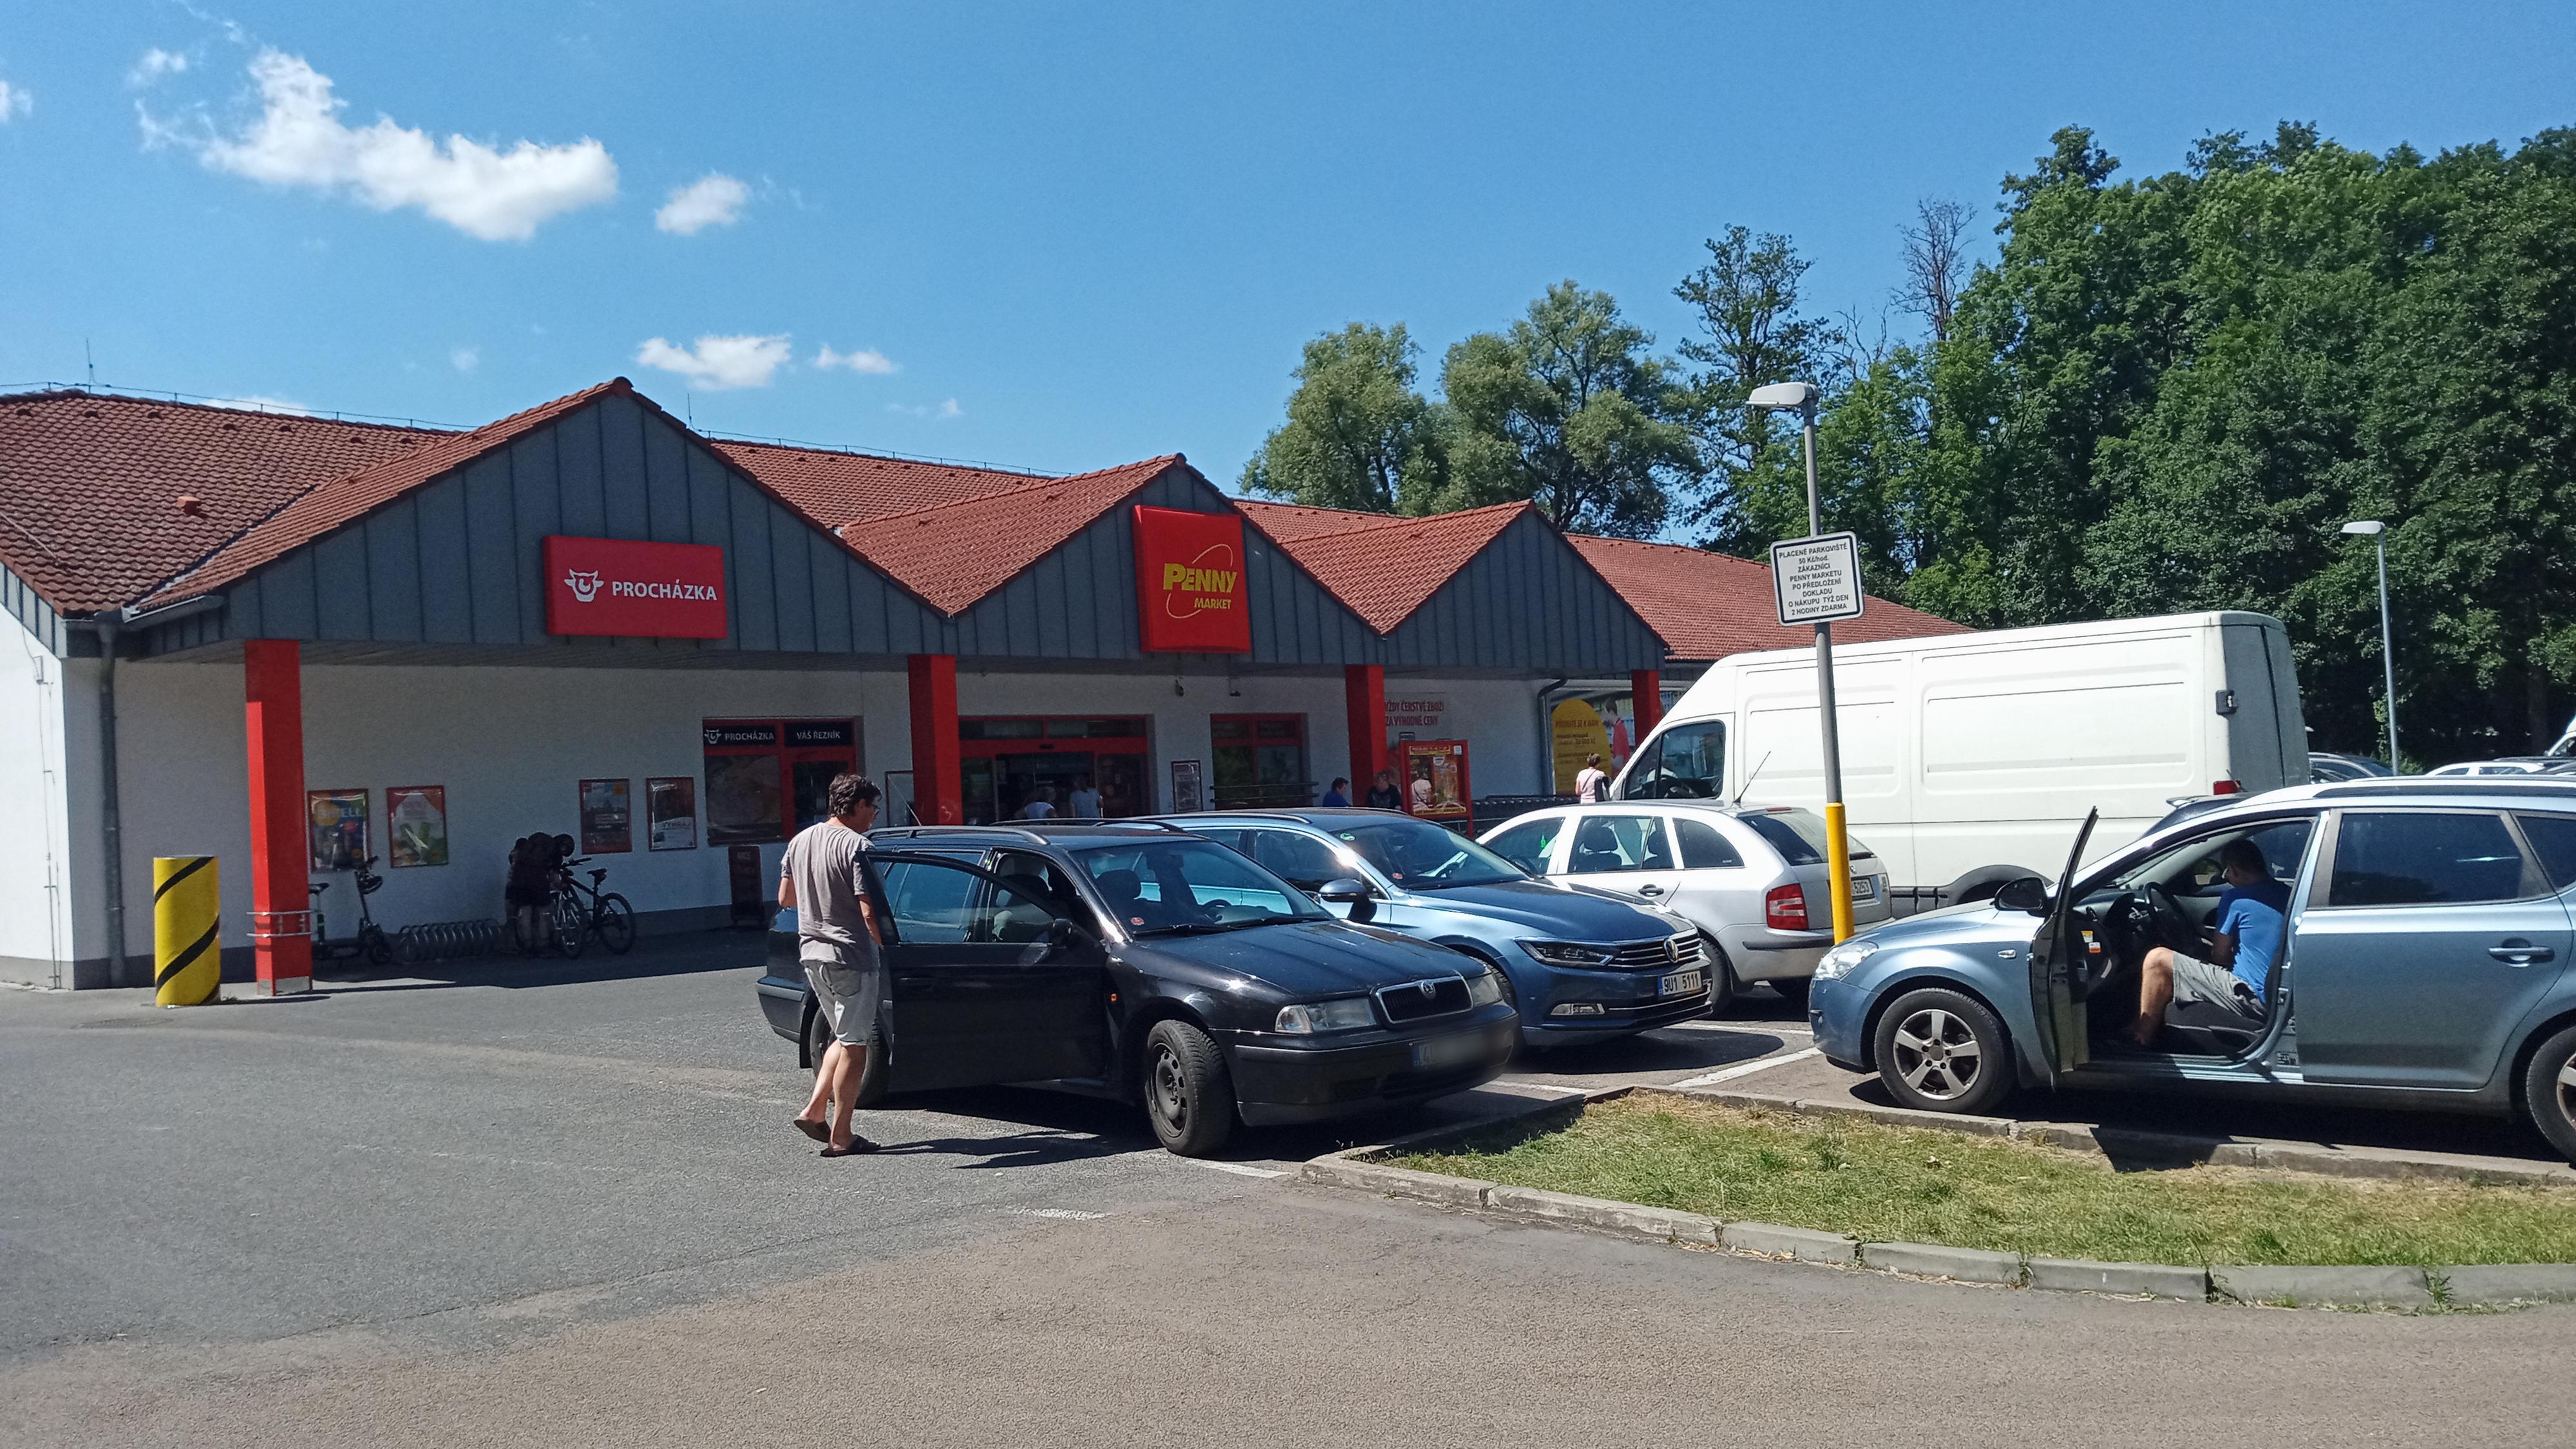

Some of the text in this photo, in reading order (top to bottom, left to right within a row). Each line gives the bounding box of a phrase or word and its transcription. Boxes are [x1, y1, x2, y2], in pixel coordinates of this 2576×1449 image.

[1779, 543, 1848, 558] PLACENÉ PARKOVIŠTÉ
[1798, 563, 1830, 573] ZÁKAZNÍCI
[1163, 564, 1237, 593] PENNY
[1790, 570, 1842, 582] PENNY MARKETU
[1803, 578, 1841, 589] PŘEDLOŽENÍ
[612, 579, 717, 601] PROCHÁZKA
[1803, 588, 1832, 597] DOKLADU
[1194, 598, 1232, 609] MARKET
[1794, 598, 1820, 606] NÁKUPU
[1821, 603, 1847, 612] ZDARMA
[725, 730, 774, 741] PROCHÁZKA
[797, 729, 840, 739] VÁŠ ŘEZNÍK
[1664, 976, 1678, 992] 9U1
[1682, 972, 1699, 989] 5111
